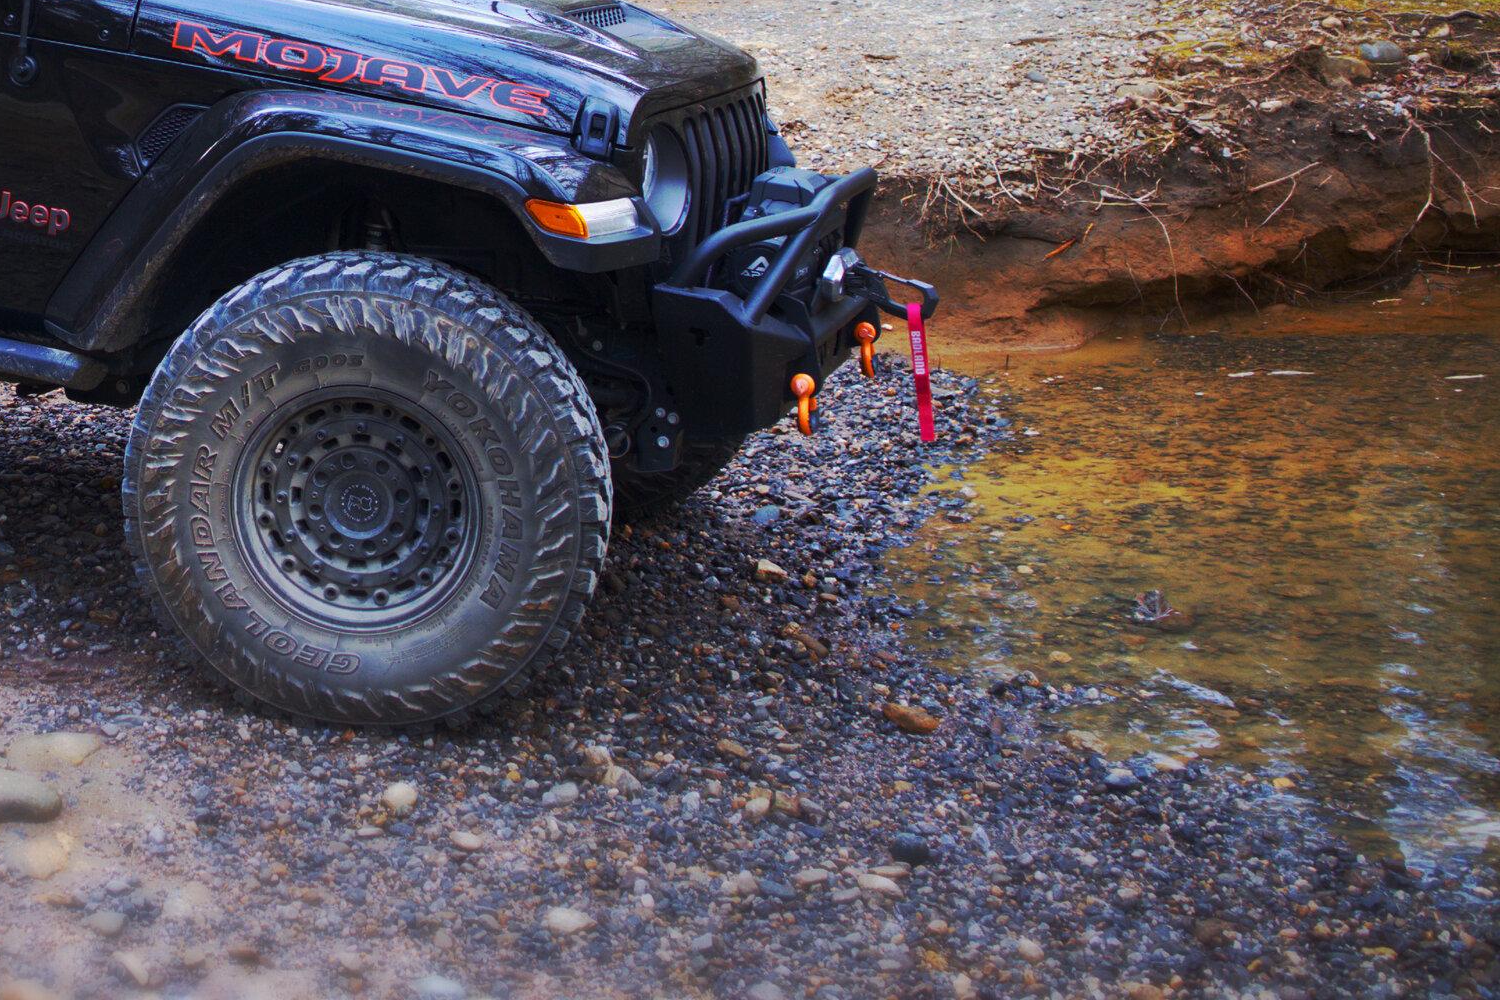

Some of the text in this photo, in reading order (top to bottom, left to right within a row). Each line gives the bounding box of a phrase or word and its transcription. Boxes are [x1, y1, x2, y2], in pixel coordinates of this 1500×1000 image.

[171, 21, 552, 117] MOJAVE
[209, 361, 281, 440] M/T
[910, 330, 926, 375] BADLAND
[422, 369, 523, 610] YOKOHAMA
[190, 444, 362, 675] GEOLANDAR
